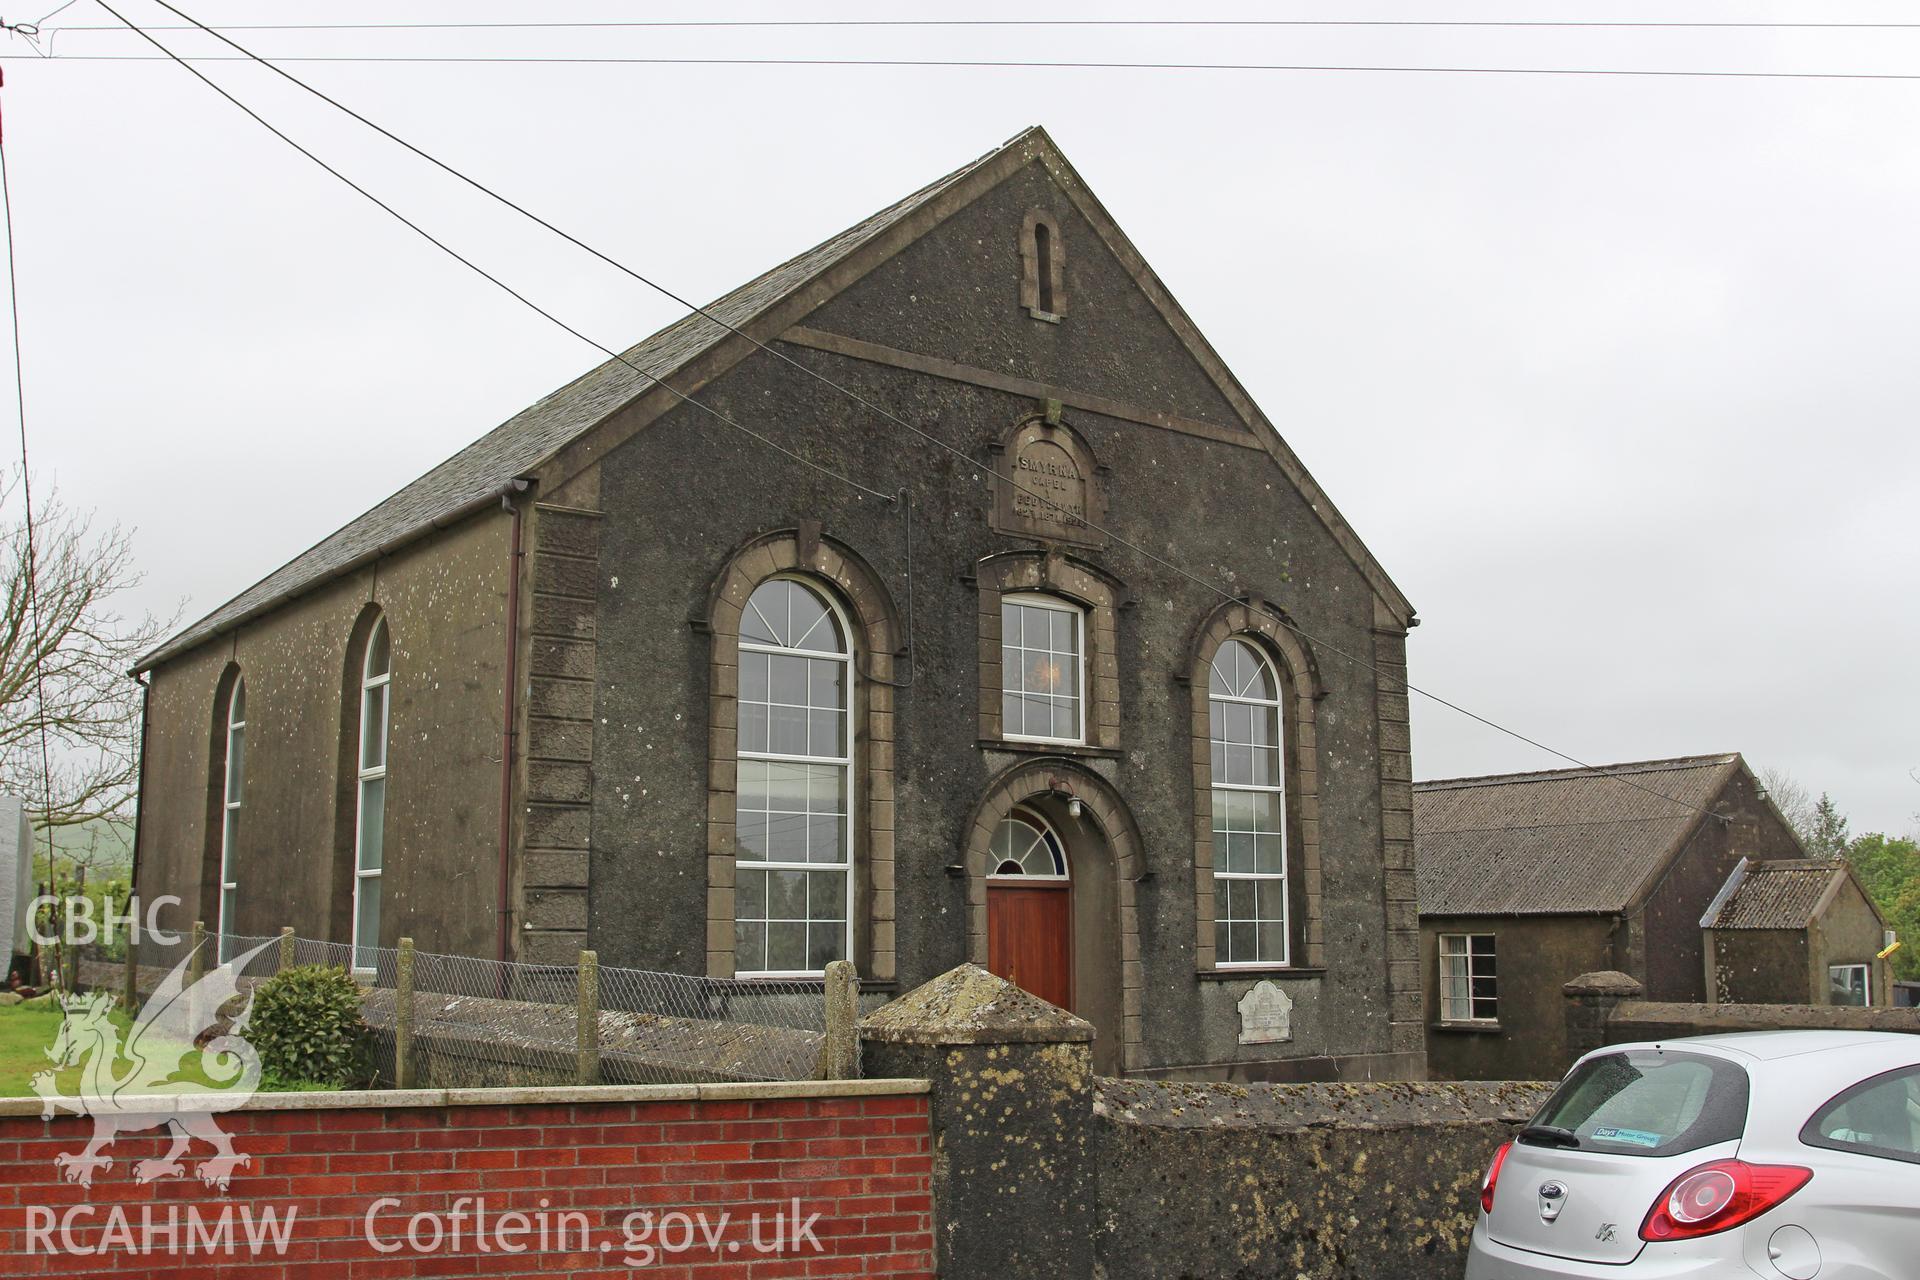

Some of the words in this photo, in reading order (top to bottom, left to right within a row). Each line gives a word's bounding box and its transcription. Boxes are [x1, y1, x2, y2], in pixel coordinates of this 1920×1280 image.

[1019, 457, 1076, 480] SMYRNA
[1032, 475, 1067, 491] CAPEL
[1597, 1128, 1616, 1137] Days
[1618, 1130, 1636, 1138] Motor
[1636, 1133, 1656, 1143] Group
